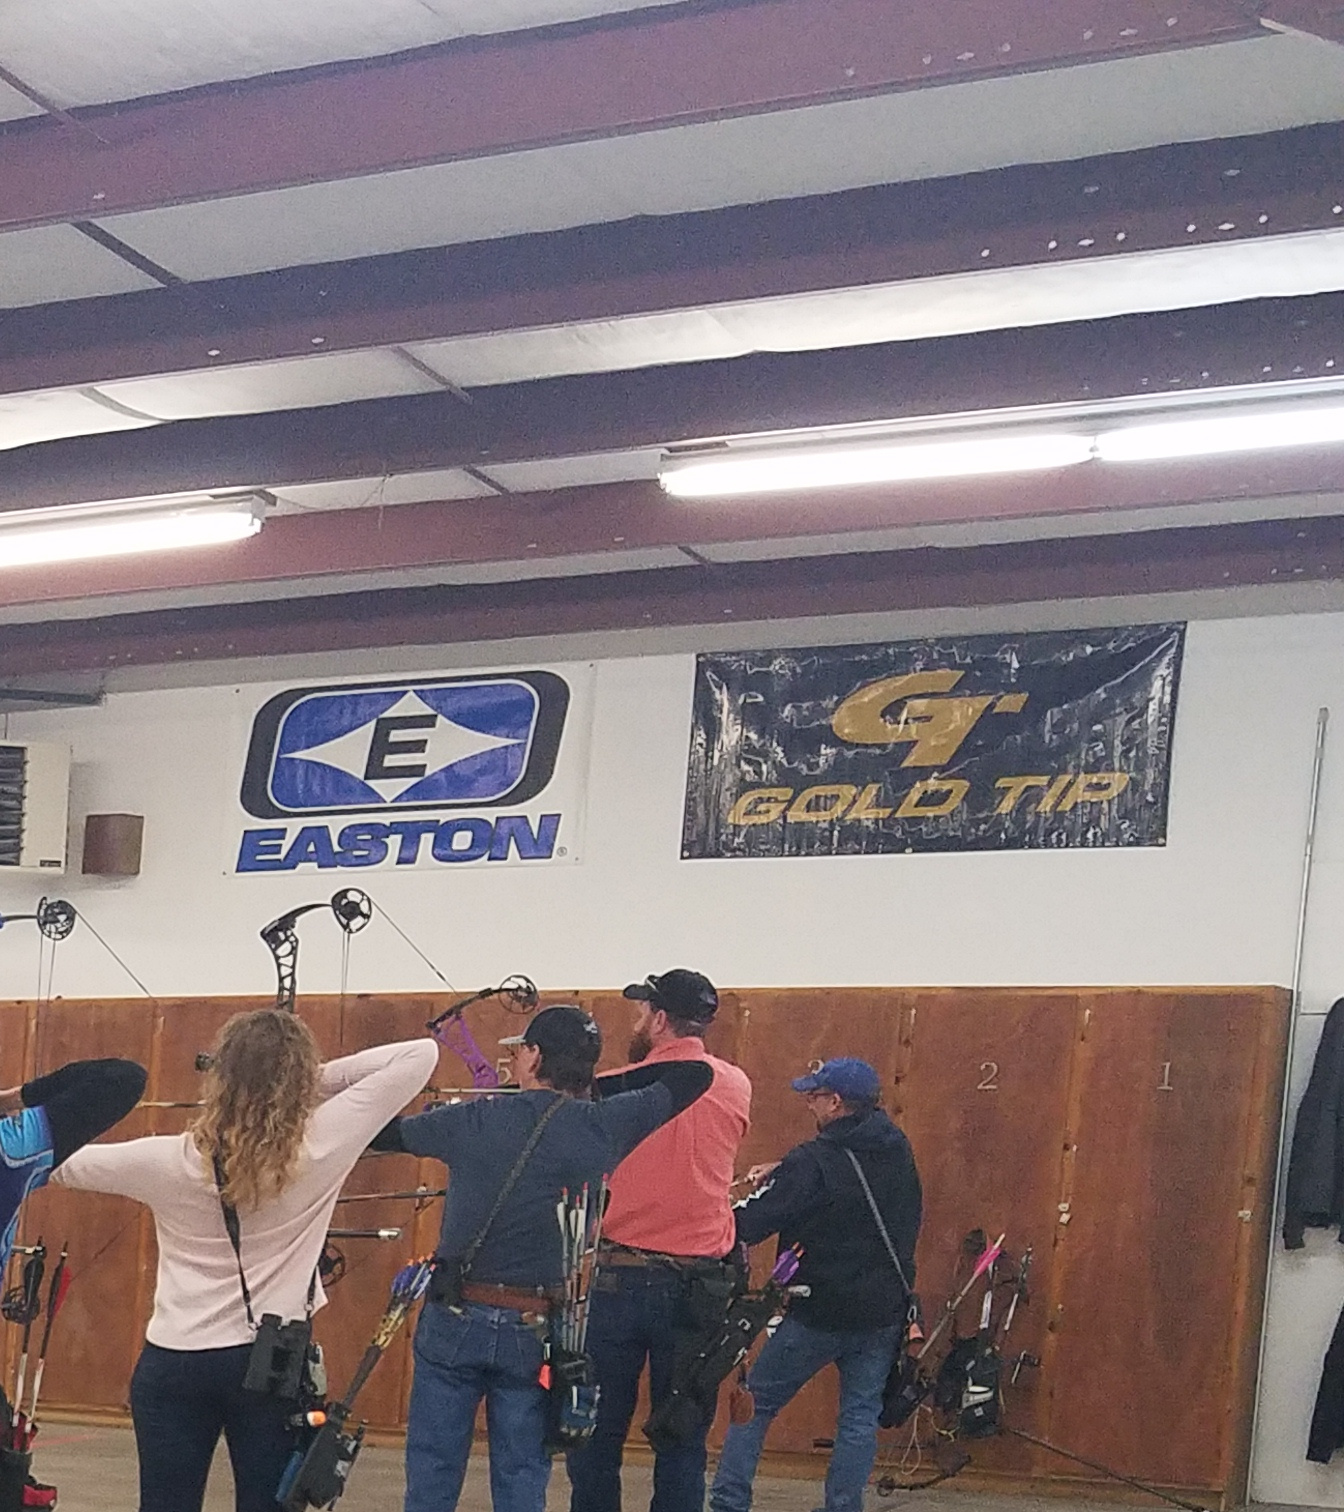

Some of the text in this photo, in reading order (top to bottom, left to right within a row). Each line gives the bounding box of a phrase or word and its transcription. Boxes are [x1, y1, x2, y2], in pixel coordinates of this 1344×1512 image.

[364, 714, 438, 780] E
[728, 772, 1130, 825] GOLD TIP
[235, 813, 562, 873] EASTON
[495, 1058, 512, 1086] 5
[977, 1062, 999, 1090] 2
[1157, 1061, 1173, 1090] 1
